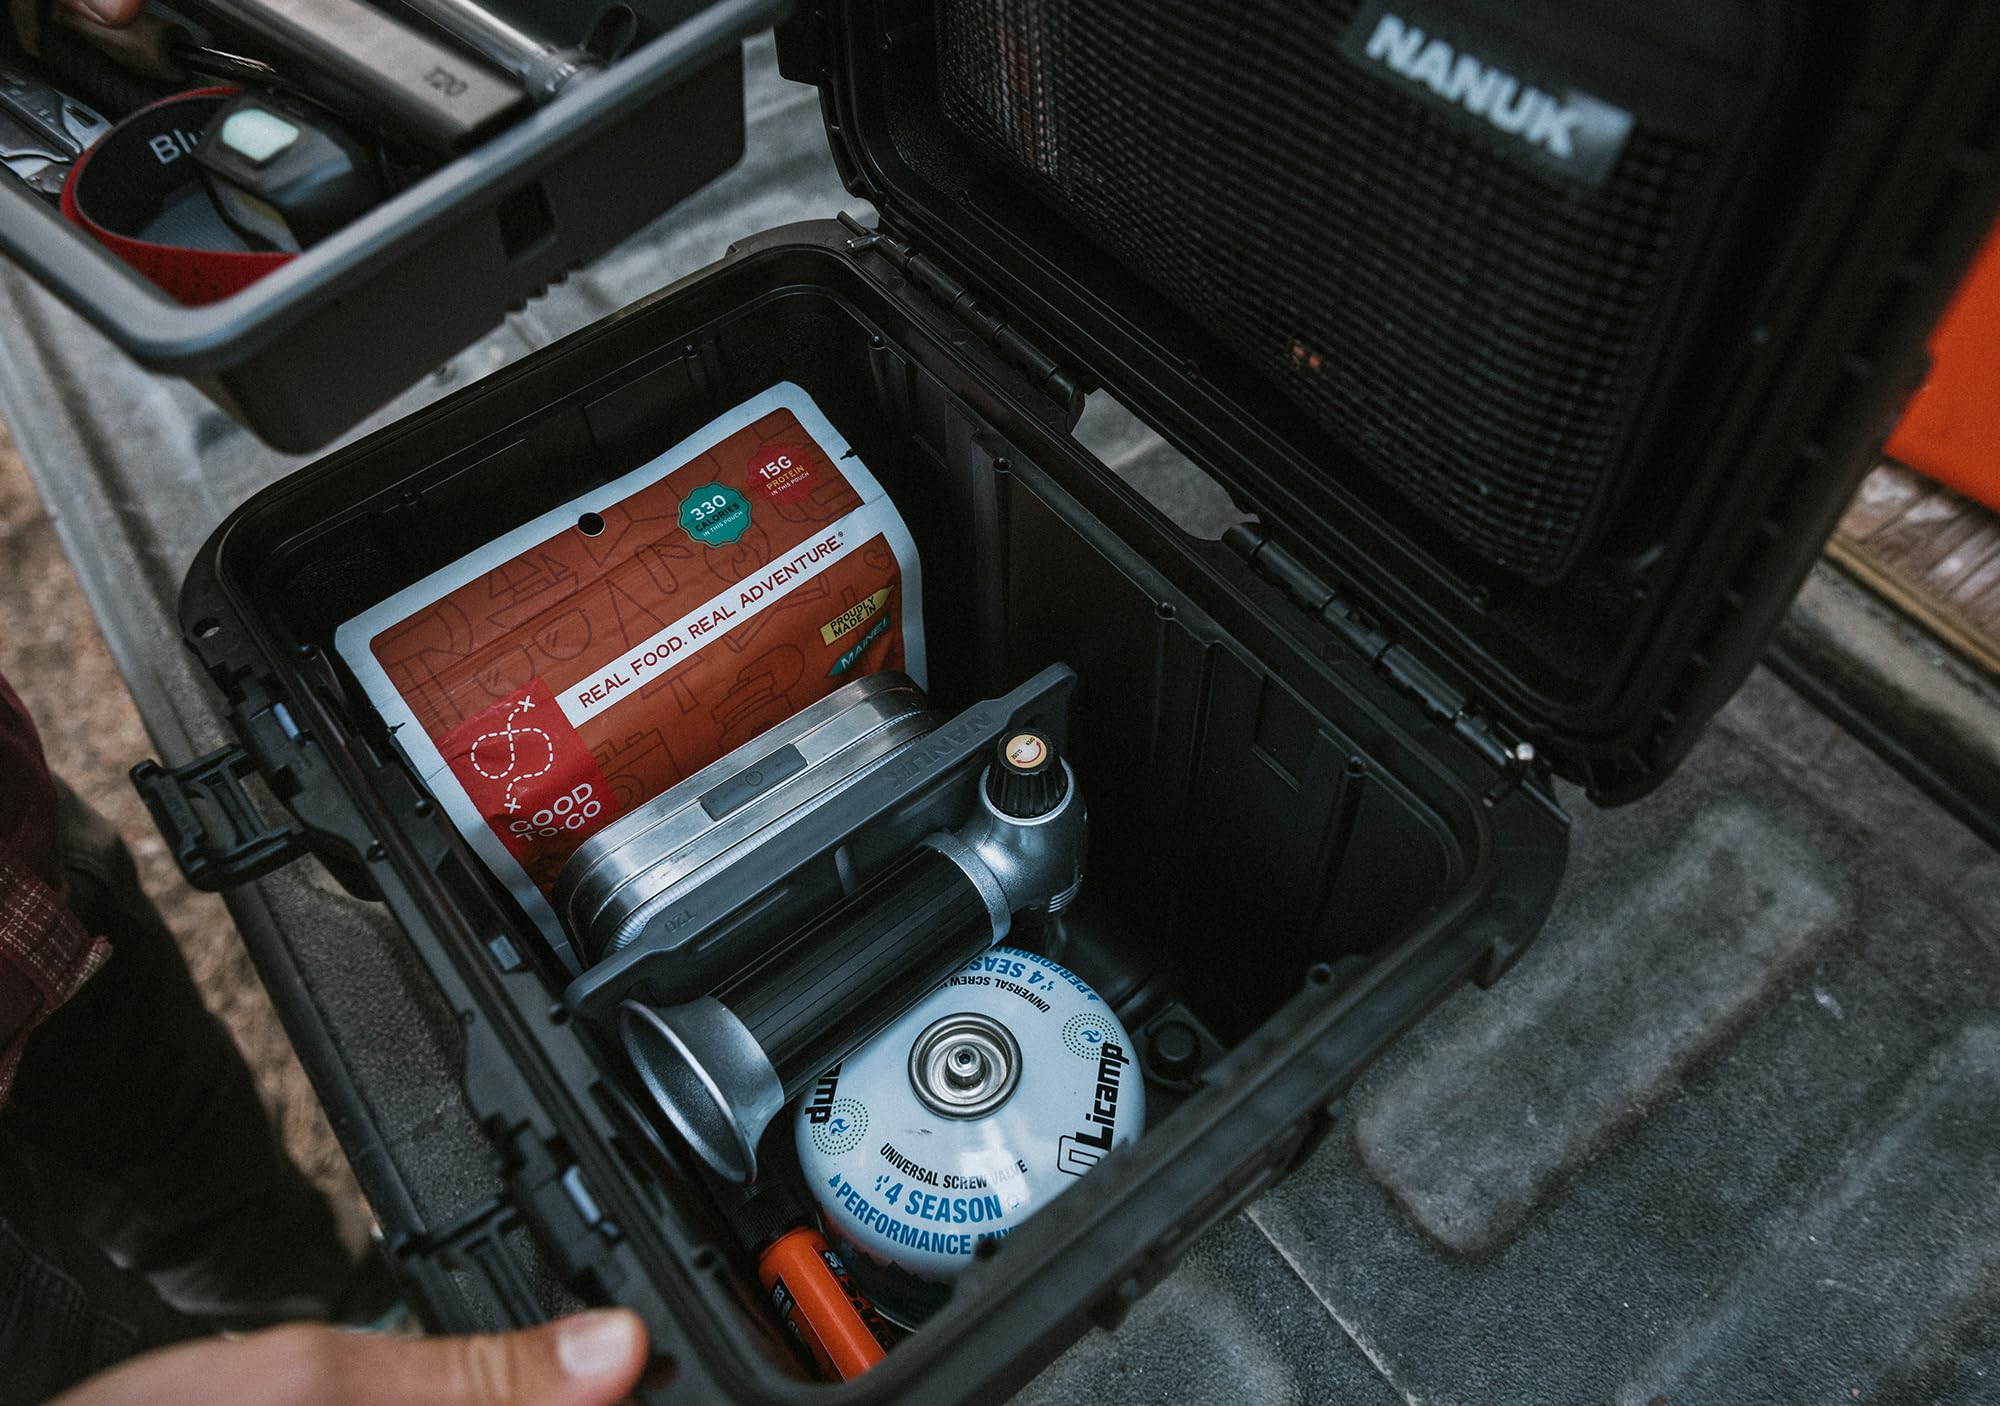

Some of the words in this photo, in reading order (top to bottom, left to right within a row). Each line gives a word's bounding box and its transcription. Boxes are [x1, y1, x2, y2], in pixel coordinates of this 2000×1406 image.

[1365, 14, 1577, 157] NANUK
[759, 455, 792, 480] 15G
[766, 465, 805, 490] PROTEIN
[771, 489, 778, 497] IN
[778, 481, 792, 493] THIS
[791, 471, 810, 486] POUCH
[690, 494, 726, 521] 330
[695, 502, 740, 532] CALORIES
[710, 521, 723, 533] THIS
[723, 510, 743, 525] POUCH
[830, 596, 875, 630] PROUDLY
[833, 613, 864, 638] MADE
[866, 604, 876, 616] IN
[578, 673, 630, 708] REAL
[630, 635, 688, 676] FOOD.
[687, 604, 737, 640] REAL
[510, 783, 593, 833] GOOD
[516, 800, 601, 842] TO-GO
[950, 975, 991, 987] SCREW
[1028, 970, 1045, 984] 4
[994, 978, 1051, 1013] UNIVERSAL
[880, 1142, 939, 1187] UNIVERSAL
[943, 1175, 987, 1190] SCREW
[835, 1181, 971, 1255] PERFORMANCE
[885, 1182, 904, 1206] 4
[904, 1190, 1003, 1224] SEASON
